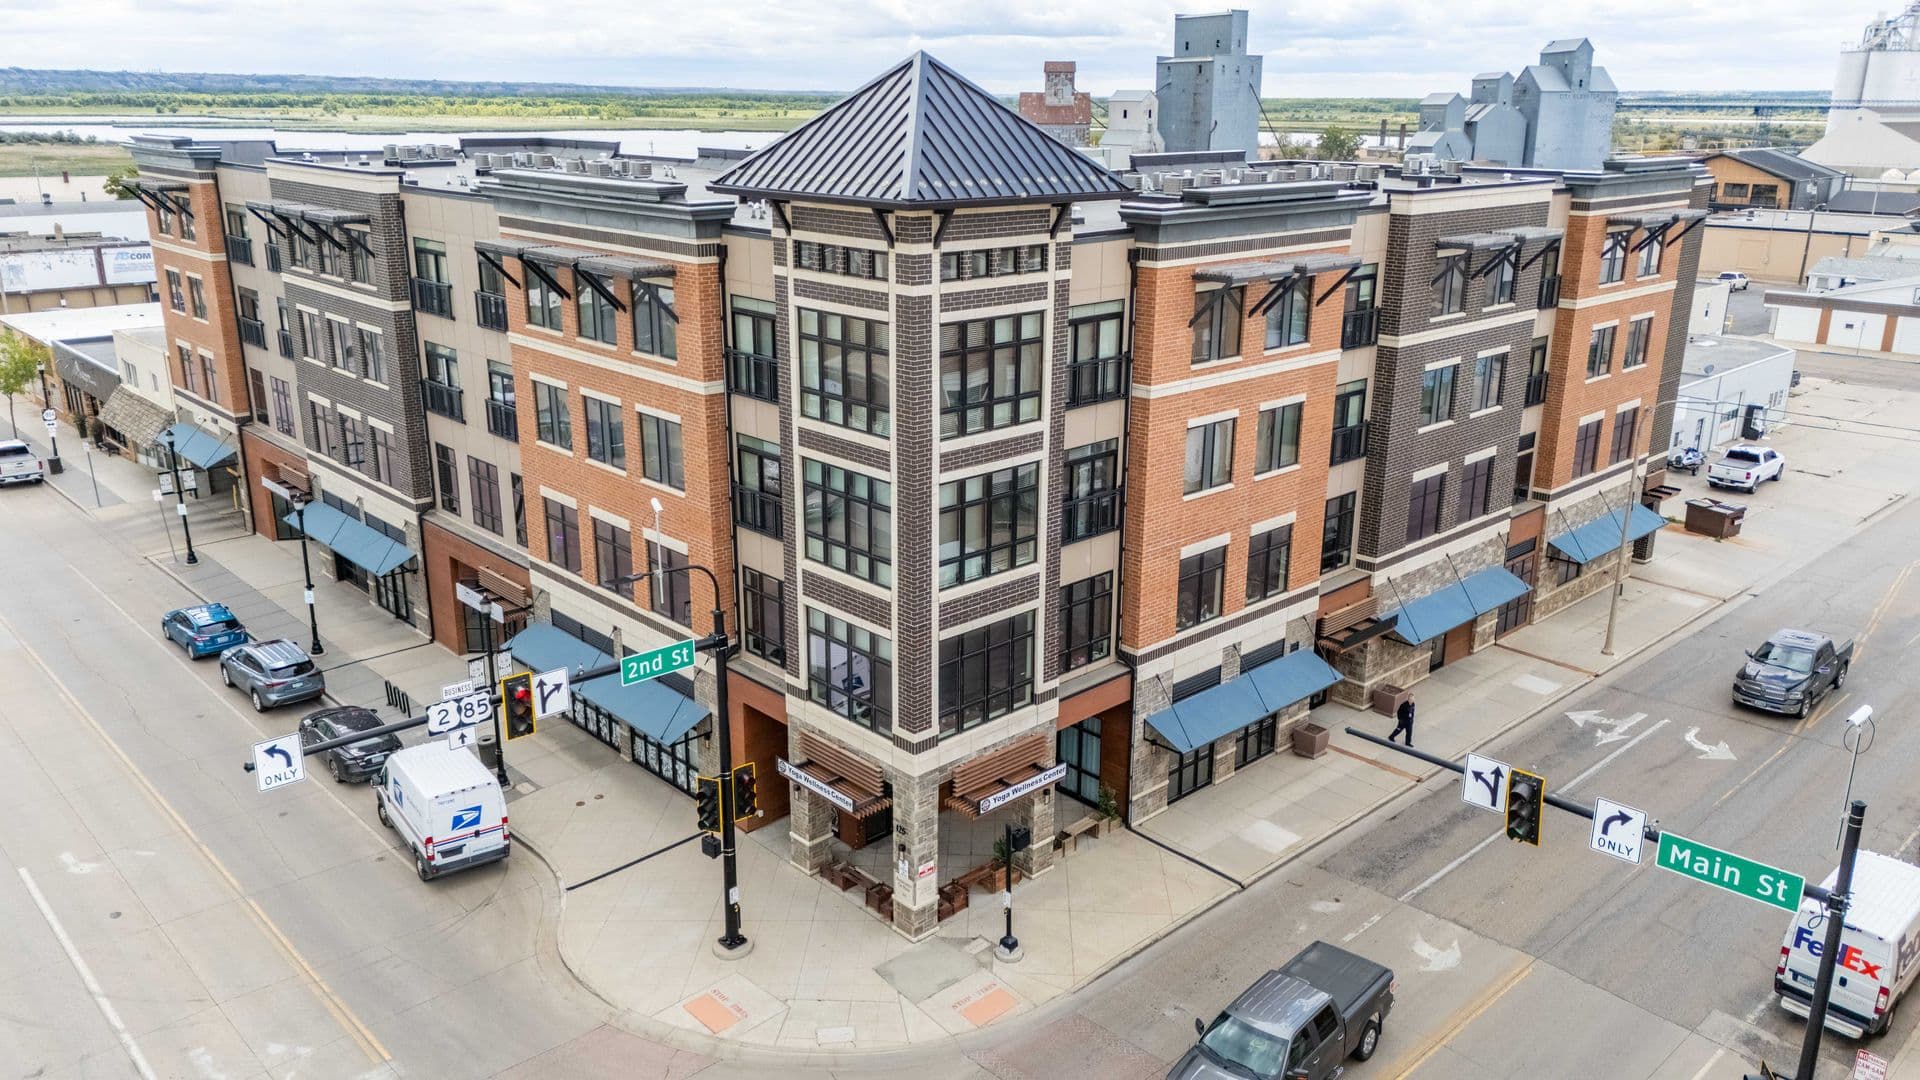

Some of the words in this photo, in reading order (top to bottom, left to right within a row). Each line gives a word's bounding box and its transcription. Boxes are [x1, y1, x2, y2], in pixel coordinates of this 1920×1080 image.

[628, 653, 662, 679] 2nd
[672, 647, 689, 666] St
[444, 682, 472, 697] BUSINESS
[437, 708, 450, 726] 2
[464, 698, 489, 719] 85
[265, 768, 298, 786] ONLY
[788, 765, 802, 779] Yoga
[803, 775, 831, 796] Wellness
[831, 791, 852, 807] Center
[992, 793, 1010, 804] Yoga
[1011, 777, 1042, 795] Wellness
[1043, 766, 1066, 781] Center
[1597, 837, 1634, 857] ONLY
[1670, 844, 1741, 886] Main
[1756, 873, 1788, 902] St
